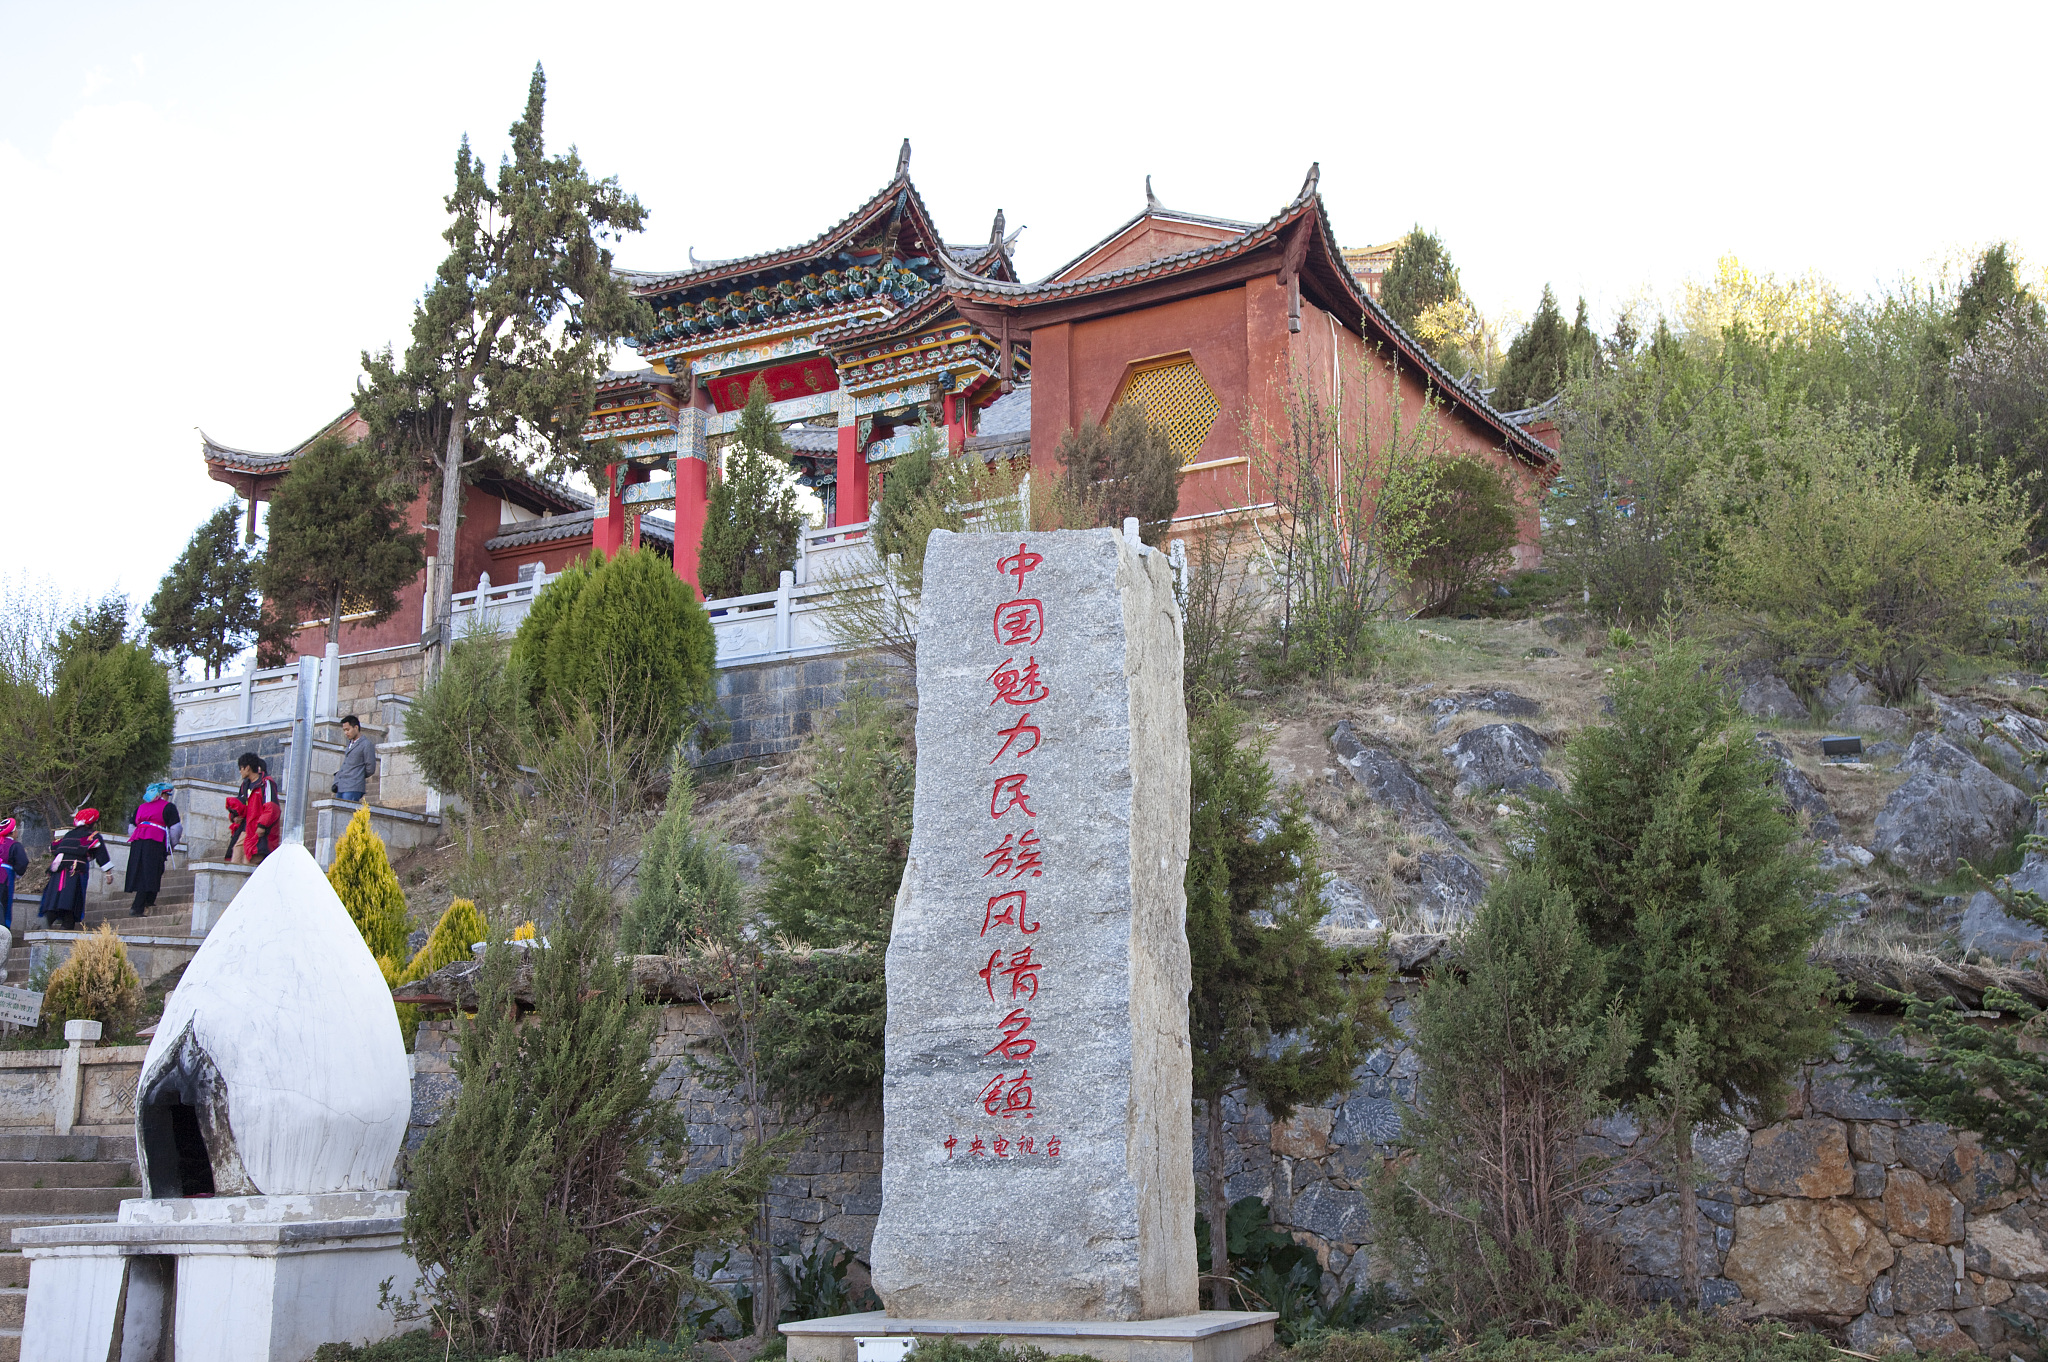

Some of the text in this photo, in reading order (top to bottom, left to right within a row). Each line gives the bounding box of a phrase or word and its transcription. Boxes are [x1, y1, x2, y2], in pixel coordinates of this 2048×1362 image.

[976, 543, 1049, 1119] 中国魅力民族风情名镇
[943, 1134, 1062, 1159] 中央电视台
